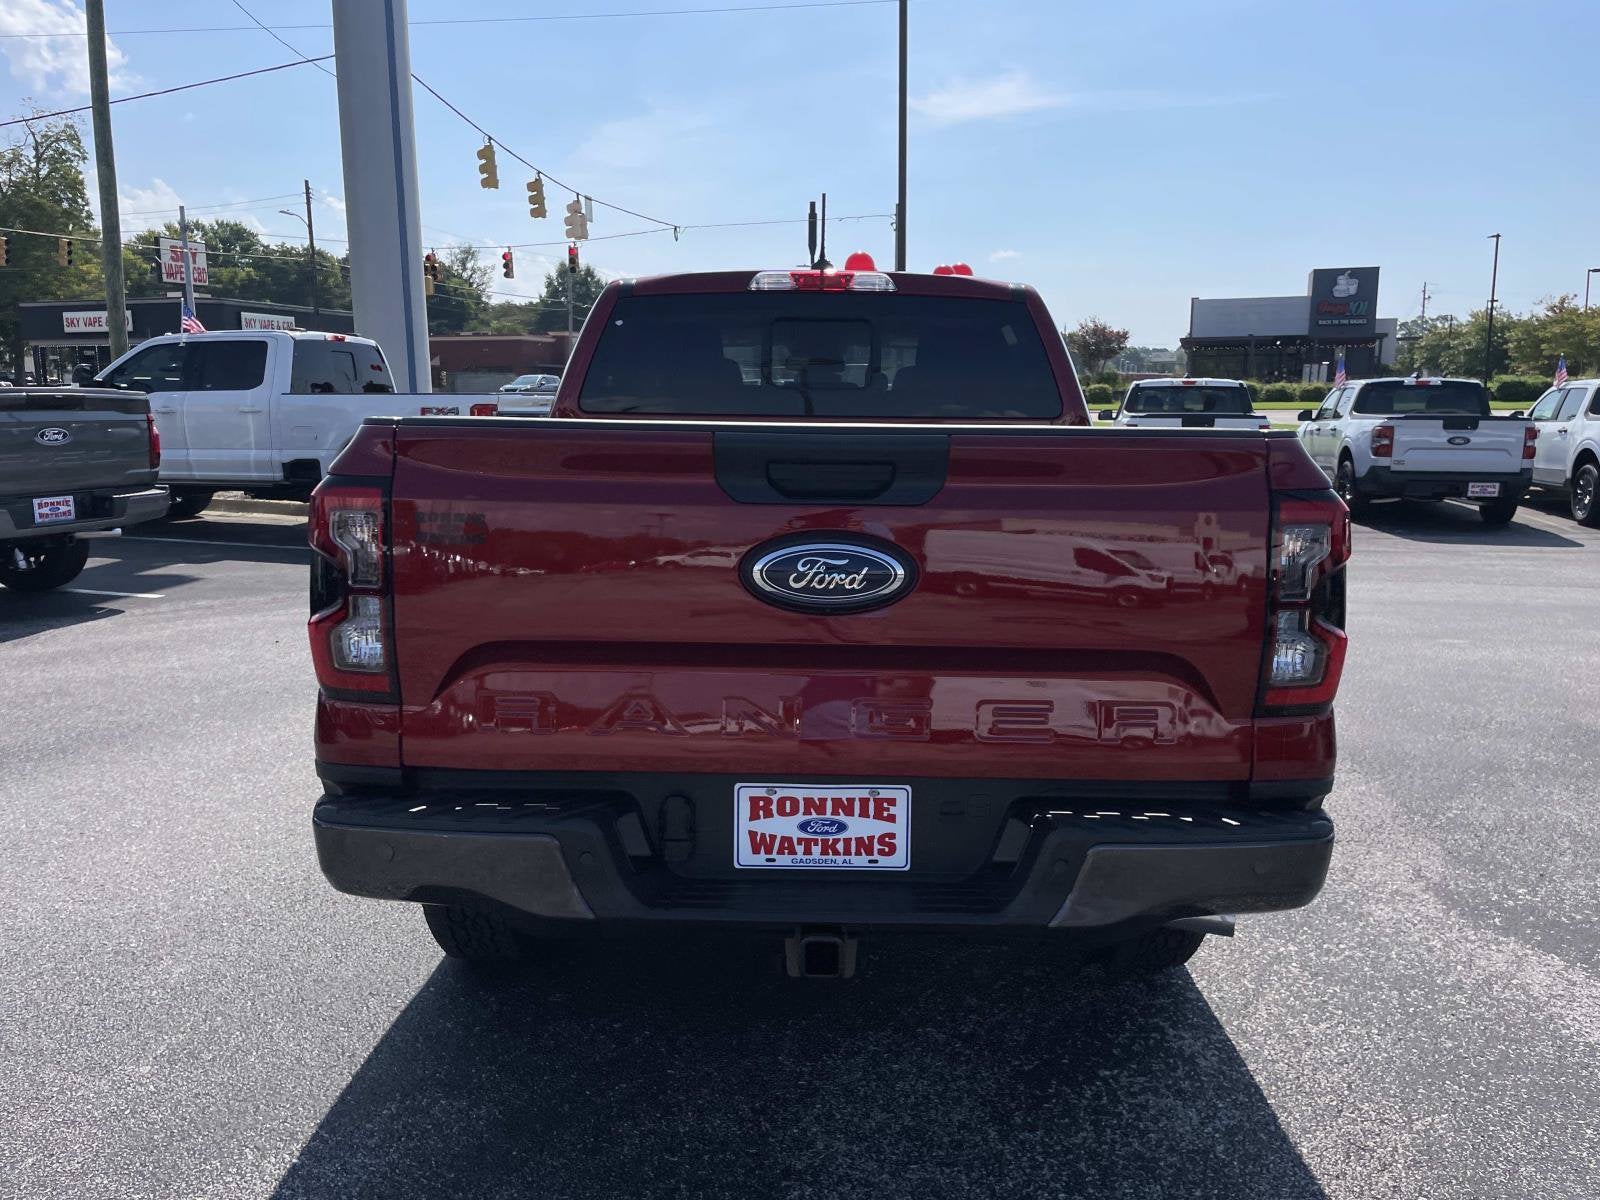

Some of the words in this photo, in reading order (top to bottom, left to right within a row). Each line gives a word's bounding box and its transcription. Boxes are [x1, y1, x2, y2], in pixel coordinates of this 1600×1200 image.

[164, 262, 185, 281] VAPE
[193, 266, 208, 283] CBD
[65, 317, 80, 328] SKY
[83, 316, 103, 327] VAPE
[244, 317, 257, 329] SKY
[259, 319, 275, 330] VAPE
[420, 406, 460, 416] FX4
[43, 430, 64, 441] Ford
[37, 499, 71, 510] RONNIE
[38, 509, 72, 519] WATKINS
[788, 556, 869, 590] Ford
[478, 690, 1178, 745] RANGER
[748, 796, 897, 824] RONNIE
[806, 820, 839, 833] Ford
[747, 829, 897, 857] WATKINS
[791, 858, 839, 866] GADSDEN,
